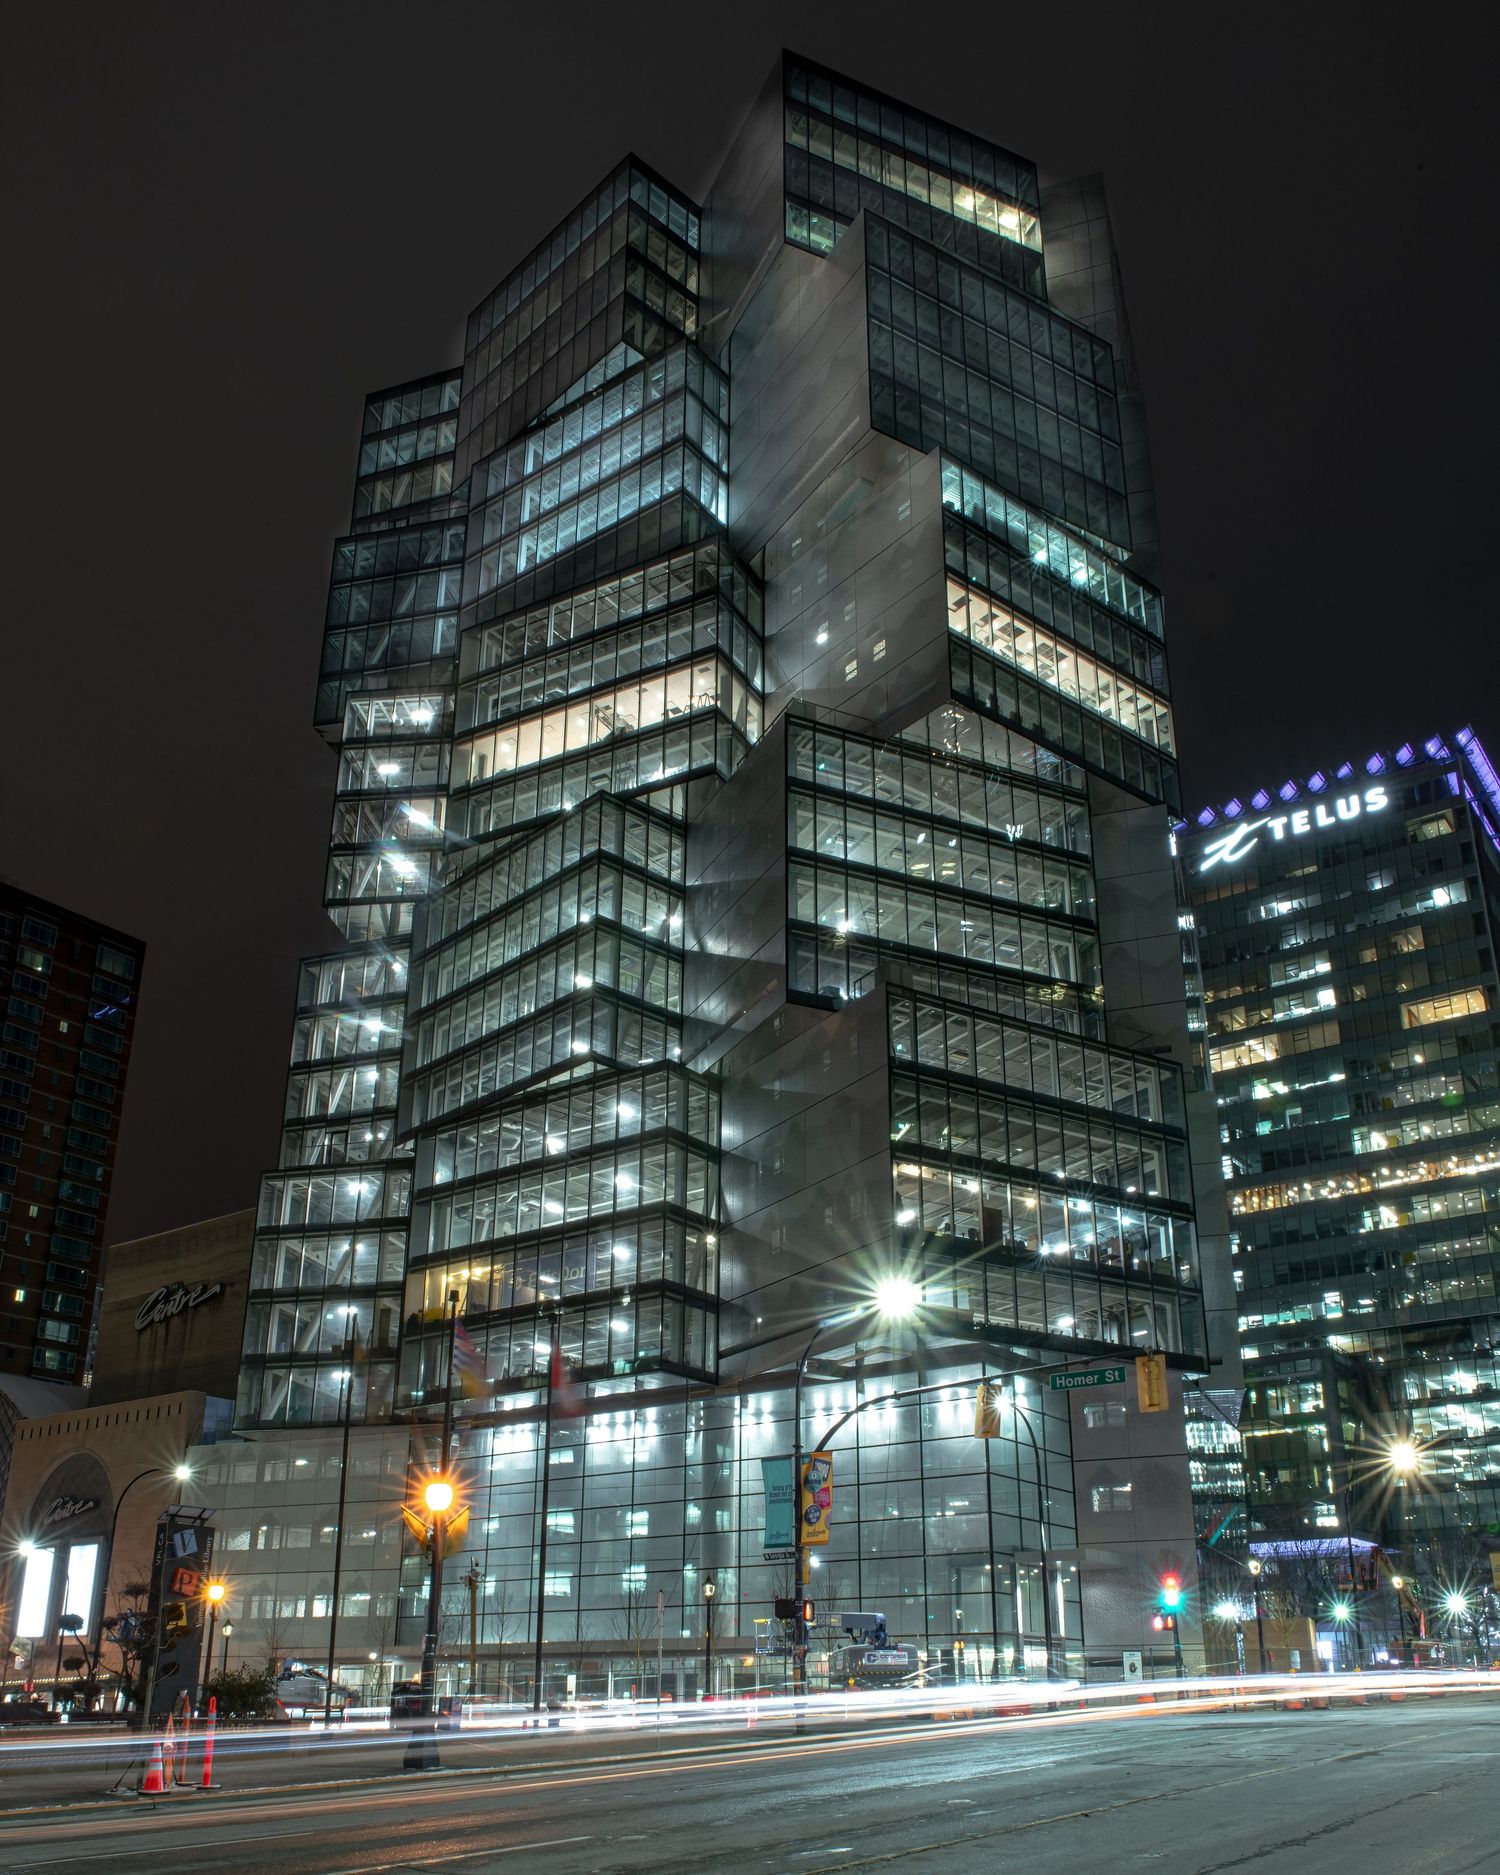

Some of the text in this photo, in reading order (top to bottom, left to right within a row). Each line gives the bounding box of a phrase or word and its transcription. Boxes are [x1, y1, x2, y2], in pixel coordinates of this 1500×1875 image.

[1267, 787, 1389, 840] TELUS
[134, 1284, 222, 1330] Centre
[1055, 1369, 1120, 1388] Homer St
[45, 1498, 95, 1524] Centre
[194, 1591, 207, 1629] Vancouv
[202, 1535, 213, 1563] Library
